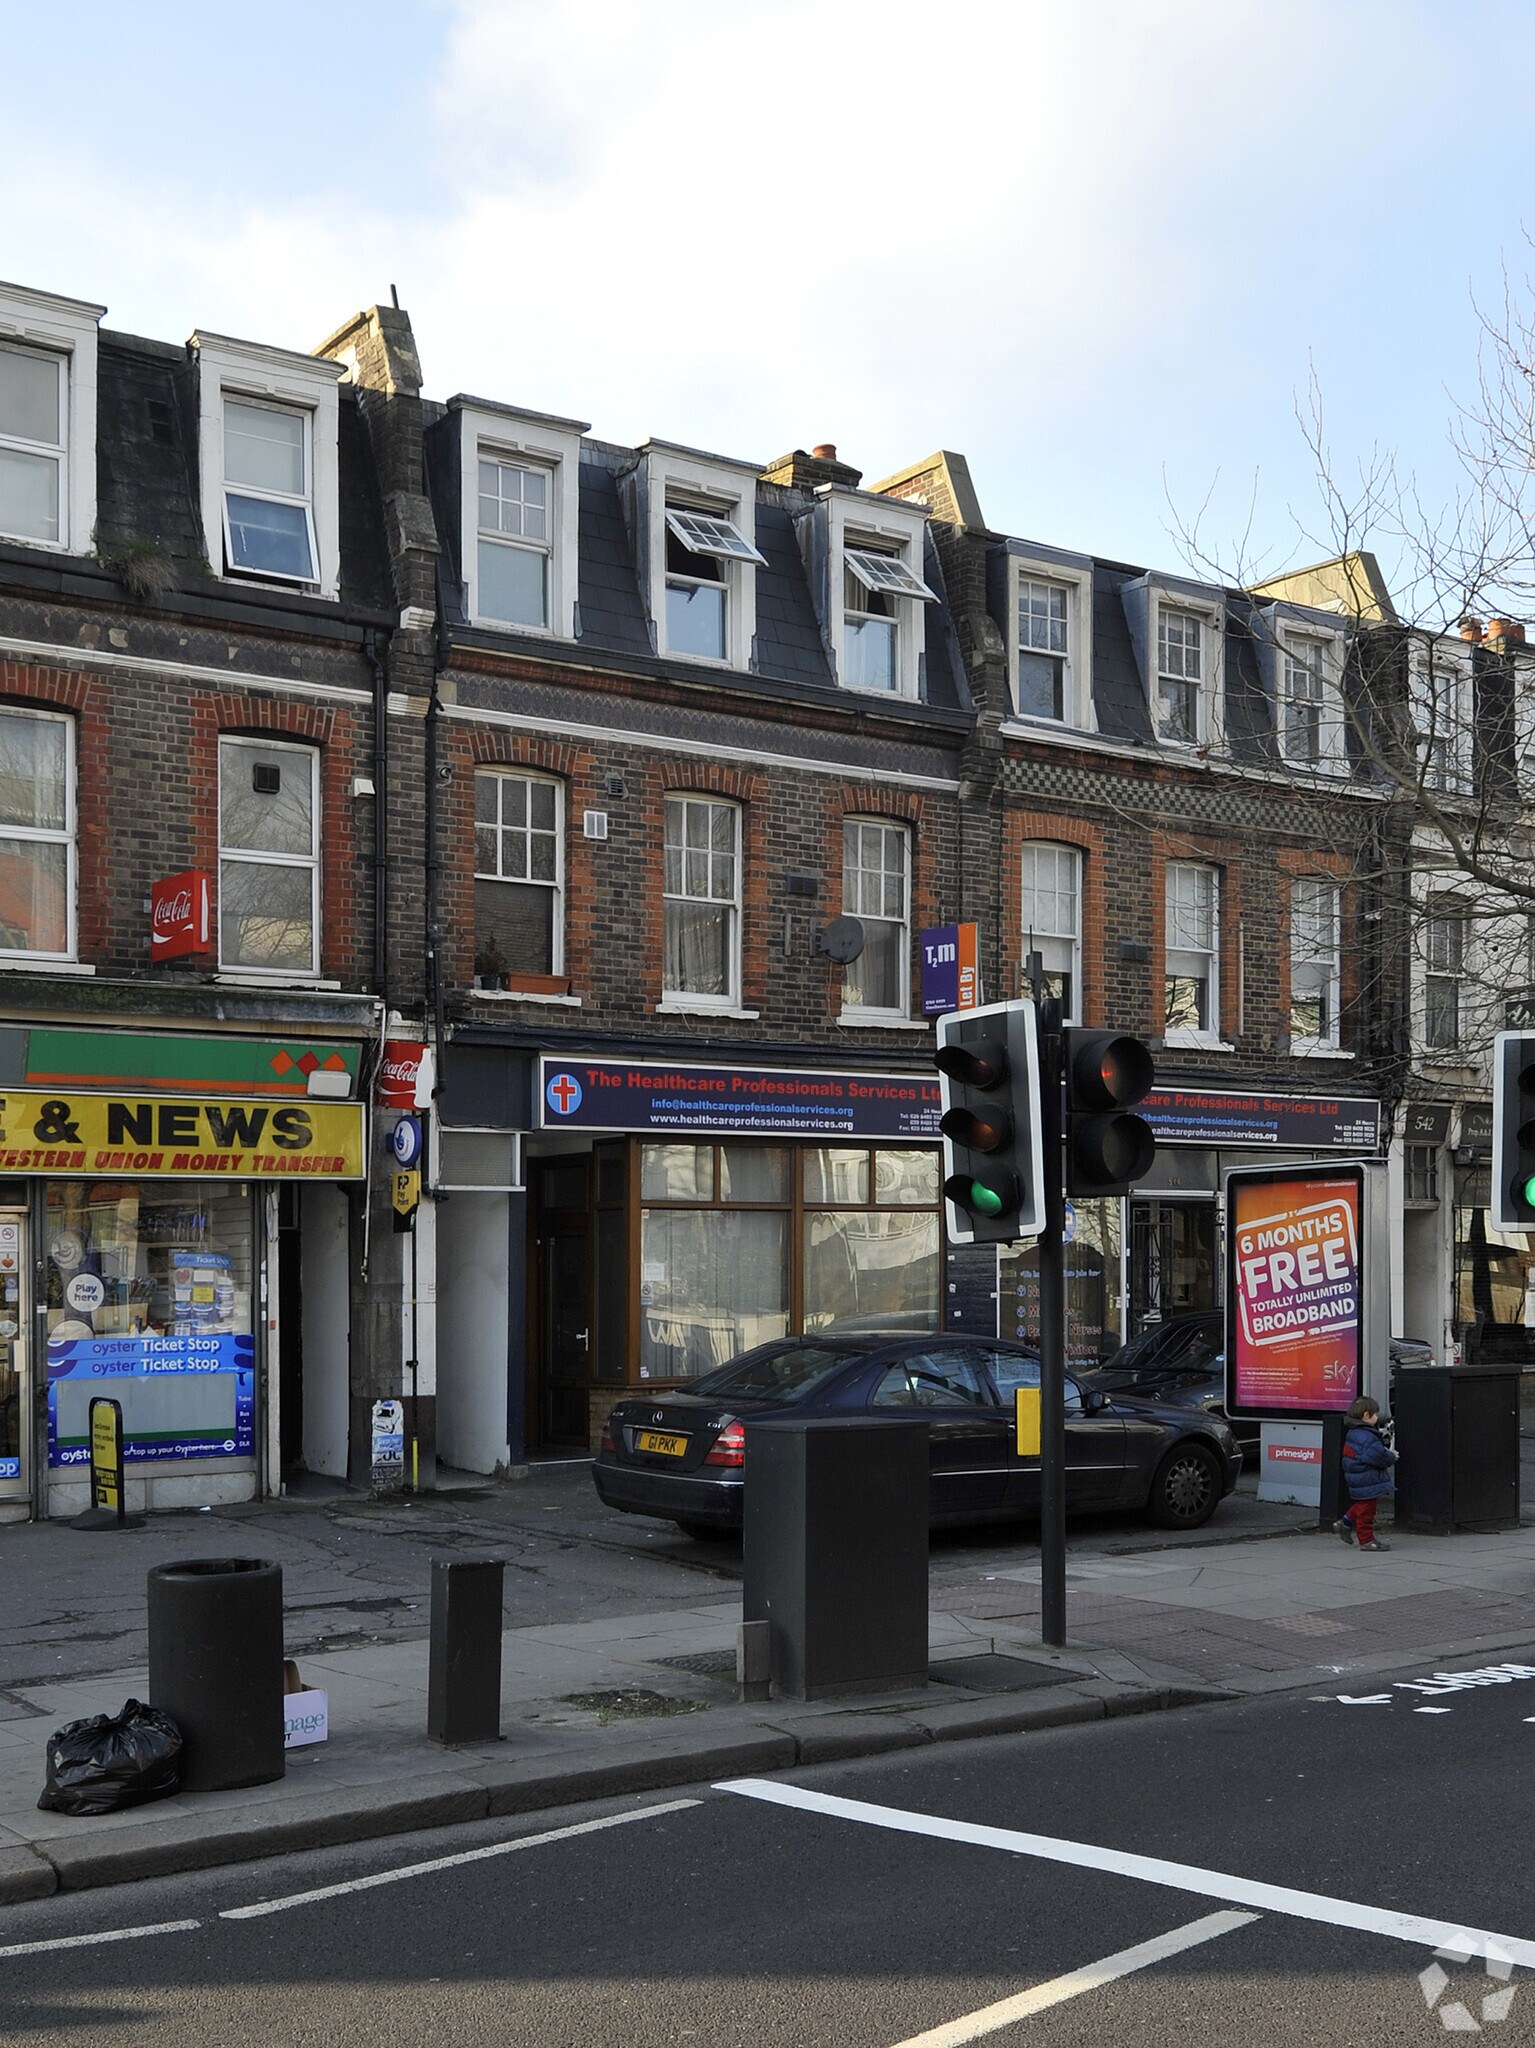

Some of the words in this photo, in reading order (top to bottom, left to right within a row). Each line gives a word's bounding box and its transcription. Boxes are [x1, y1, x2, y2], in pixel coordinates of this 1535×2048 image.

[586, 1070, 622, 1087] The
[627, 1073, 726, 1092] Healthcare
[731, 1076, 843, 1097] Professionals
[849, 1083, 916, 1100] Services
[651, 1098, 854, 1117] info@healthcareprofessionalservices.org
[1175, 1094, 1260, 1111] Professionals
[1263, 1101, 1315, 1114] Services
[1319, 1102, 1339, 1114] Ltd
[34, 1100, 83, 1144] &
[108, 1103, 313, 1150] NEWS
[650, 1114, 854, 1131] www.healthcareprofessionalservices.org
[1414, 1116, 1435, 1131] 542
[1151, 1127, 1278, 1141] ealthcareprofessionalservices.org
[0, 1150, 86, 1168] ESTERN
[95, 1152, 164, 1169] UNION
[171, 1153, 244, 1171] MONEY
[252, 1155, 345, 1173] TRANSFER
[1241, 1235, 1254, 1254] 6
[1257, 1212, 1343, 1251] MONTHS
[1241, 1237, 1350, 1299] FREE
[74, 1293, 98, 1302] here
[75, 1284, 97, 1295] Play
[1251, 1295, 1293, 1313] TOTALLY
[1295, 1282, 1352, 1304] UNLIMITED
[1252, 1297, 1355, 1334] BROADBAND
[93, 1341, 137, 1356] oyster
[141, 1339, 185, 1352] Ticket
[188, 1338, 220, 1352] Stop
[1063, 1344, 1098, 1355] Visitors
[92, 1362, 137, 1376] oyster
[141, 1358, 184, 1372] Ticket
[187, 1357, 219, 1372] Stop
[1323, 1360, 1356, 1385] sky
[133, 1447, 146, 1457] top
[147, 1448, 157, 1456] up
[157, 1446, 173, 1455] your
[175, 1444, 198, 1454] Oyster
[1275, 1448, 1315, 1461] primesight
